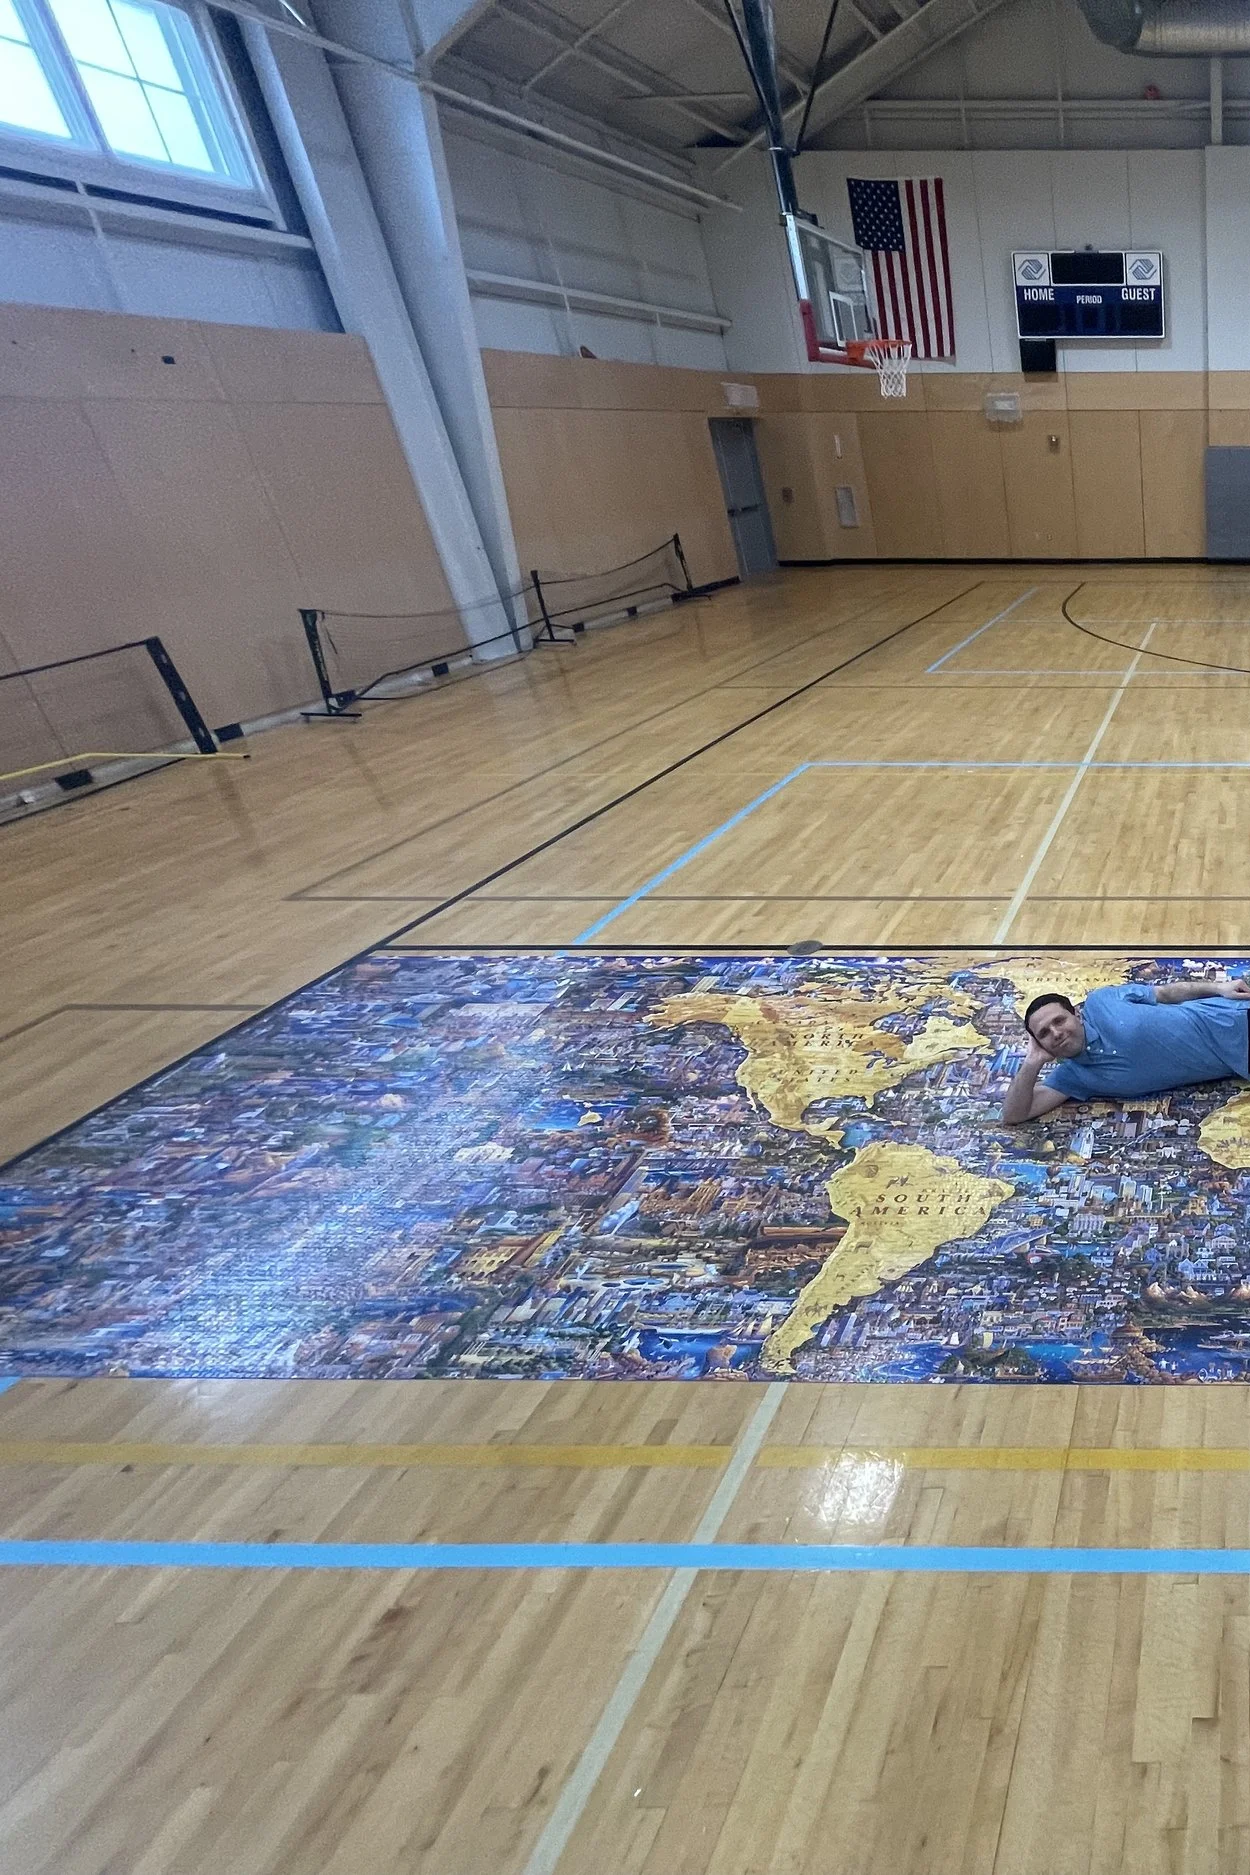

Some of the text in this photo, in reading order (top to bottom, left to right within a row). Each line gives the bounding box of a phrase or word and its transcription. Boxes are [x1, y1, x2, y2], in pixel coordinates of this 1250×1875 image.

[1024, 288, 1055, 301] HOME
[1121, 287, 1156, 301] GUEST
[1076, 295, 1103, 304] PERIOD
[875, 1193, 972, 1203] SOUTH
[849, 1206, 986, 1216] AMERICA
